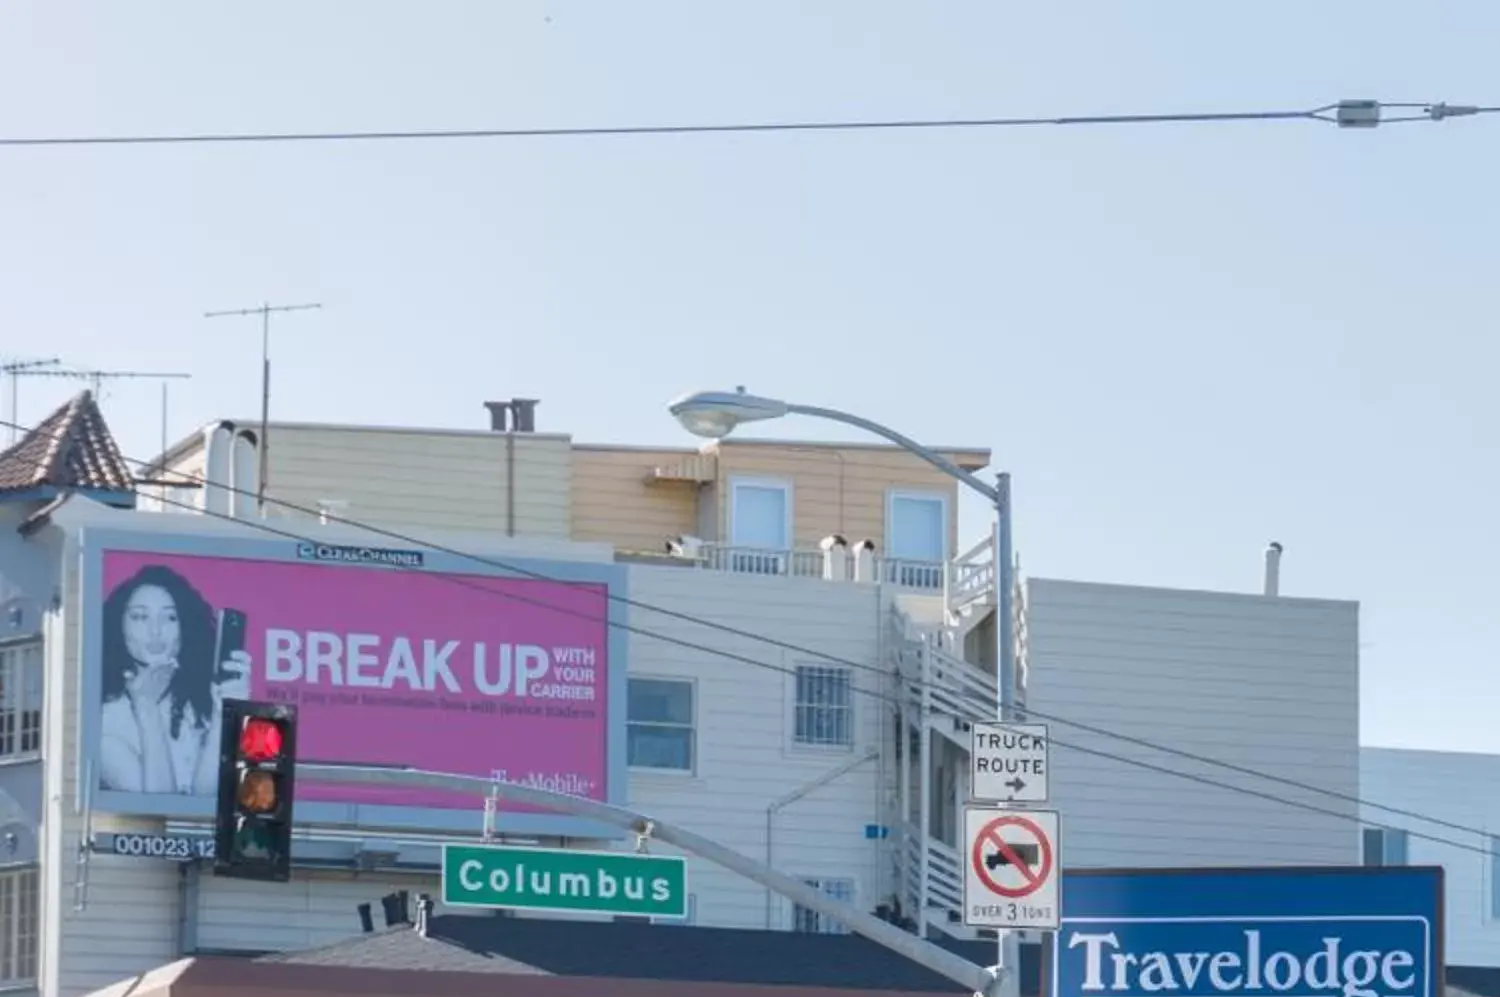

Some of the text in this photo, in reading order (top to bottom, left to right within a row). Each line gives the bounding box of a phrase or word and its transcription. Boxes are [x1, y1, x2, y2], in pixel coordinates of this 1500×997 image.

[265, 628, 549, 696] BREAK UP
[552, 647, 595, 666] WITH
[554, 667, 595, 683] YOUR
[530, 682, 595, 700] CARRIER
[976, 733, 1044, 751] TRUCK
[977, 757, 1044, 775] ROUTE
[116, 836, 189, 856] 001023
[459, 859, 671, 901] Columbus
[973, 905, 1001, 917] OVER
[1007, 903, 1017, 921] 3
